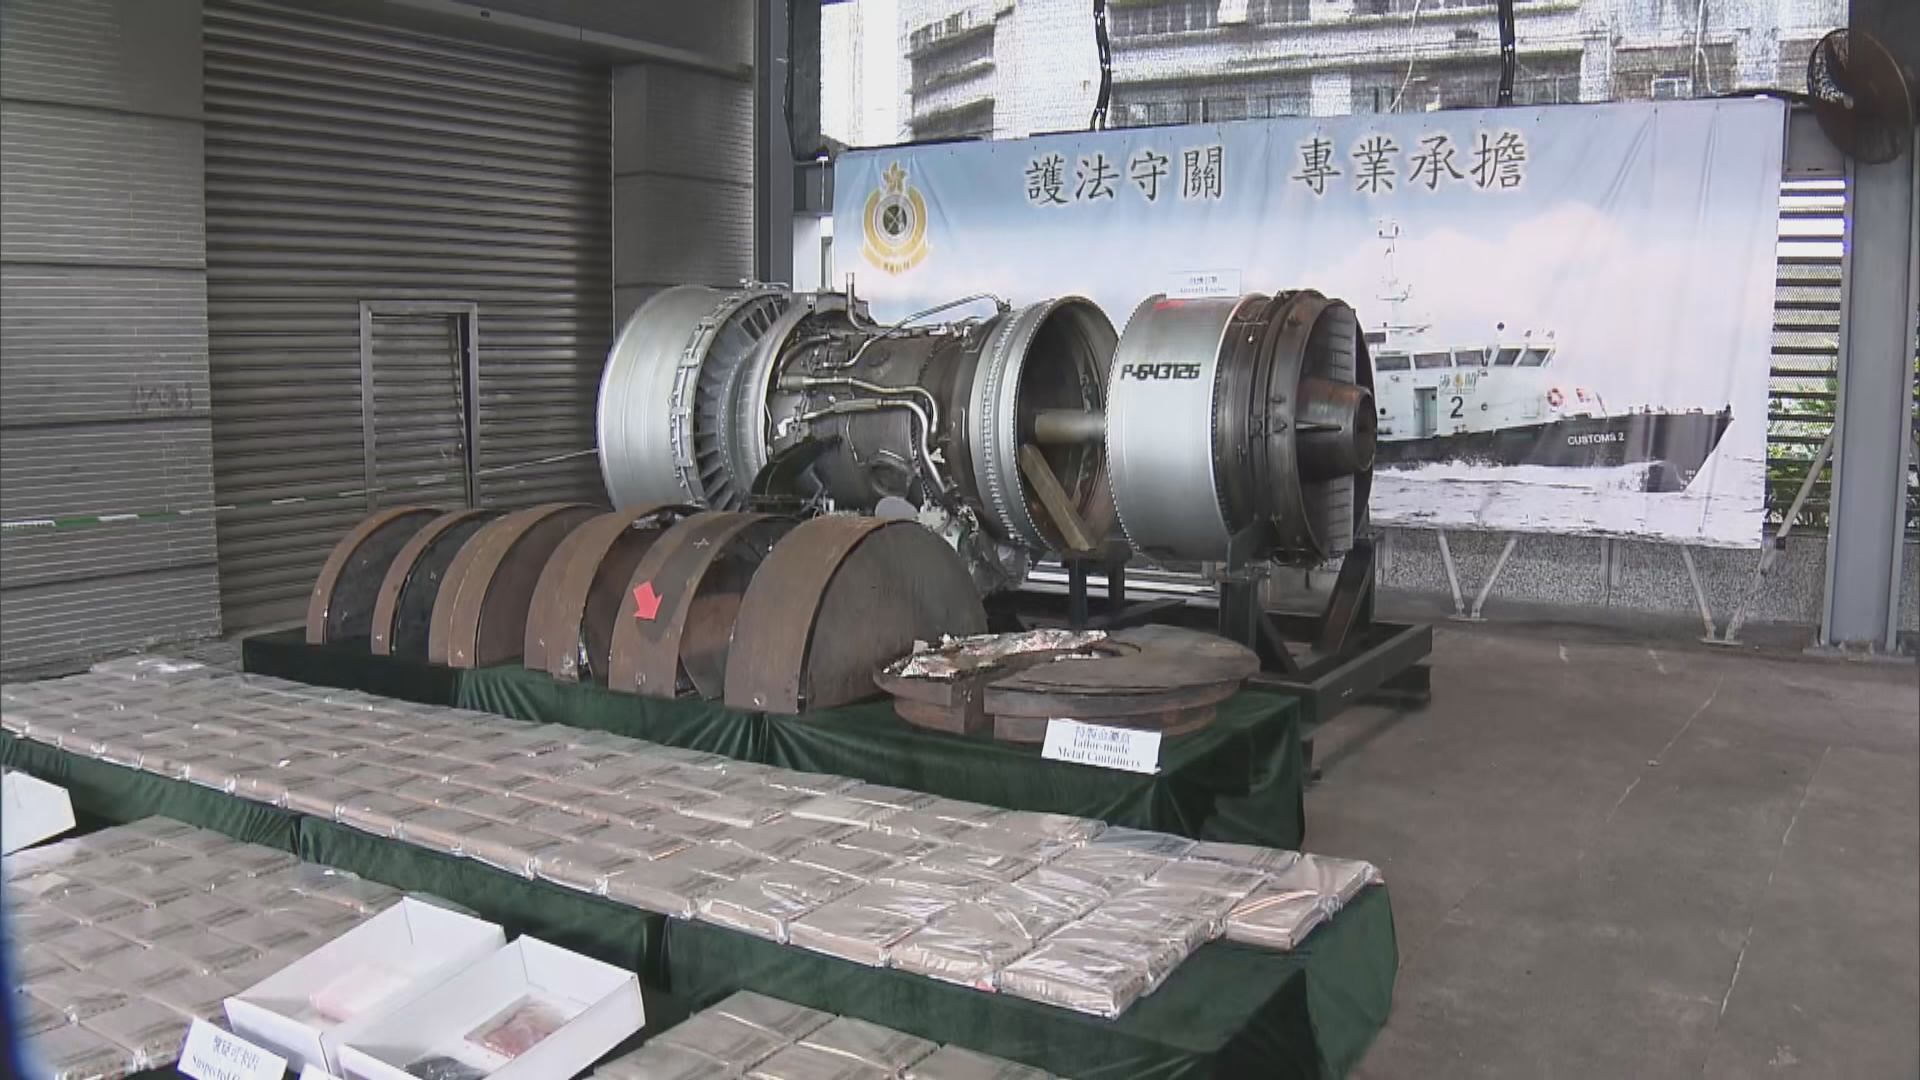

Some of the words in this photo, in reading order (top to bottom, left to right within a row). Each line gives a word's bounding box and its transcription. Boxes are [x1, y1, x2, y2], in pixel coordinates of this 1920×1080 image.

[1025, 145, 1223, 205] 護法守關
[1291, 131, 1528, 197] 專業承擔
[1449, 395, 1465, 419] 2
[1567, 433, 1617, 446] CUSTOMS
[1617, 431, 1625, 441] 2
[1058, 745, 1086, 760] Metal
[1087, 751, 1141, 768] Containers
